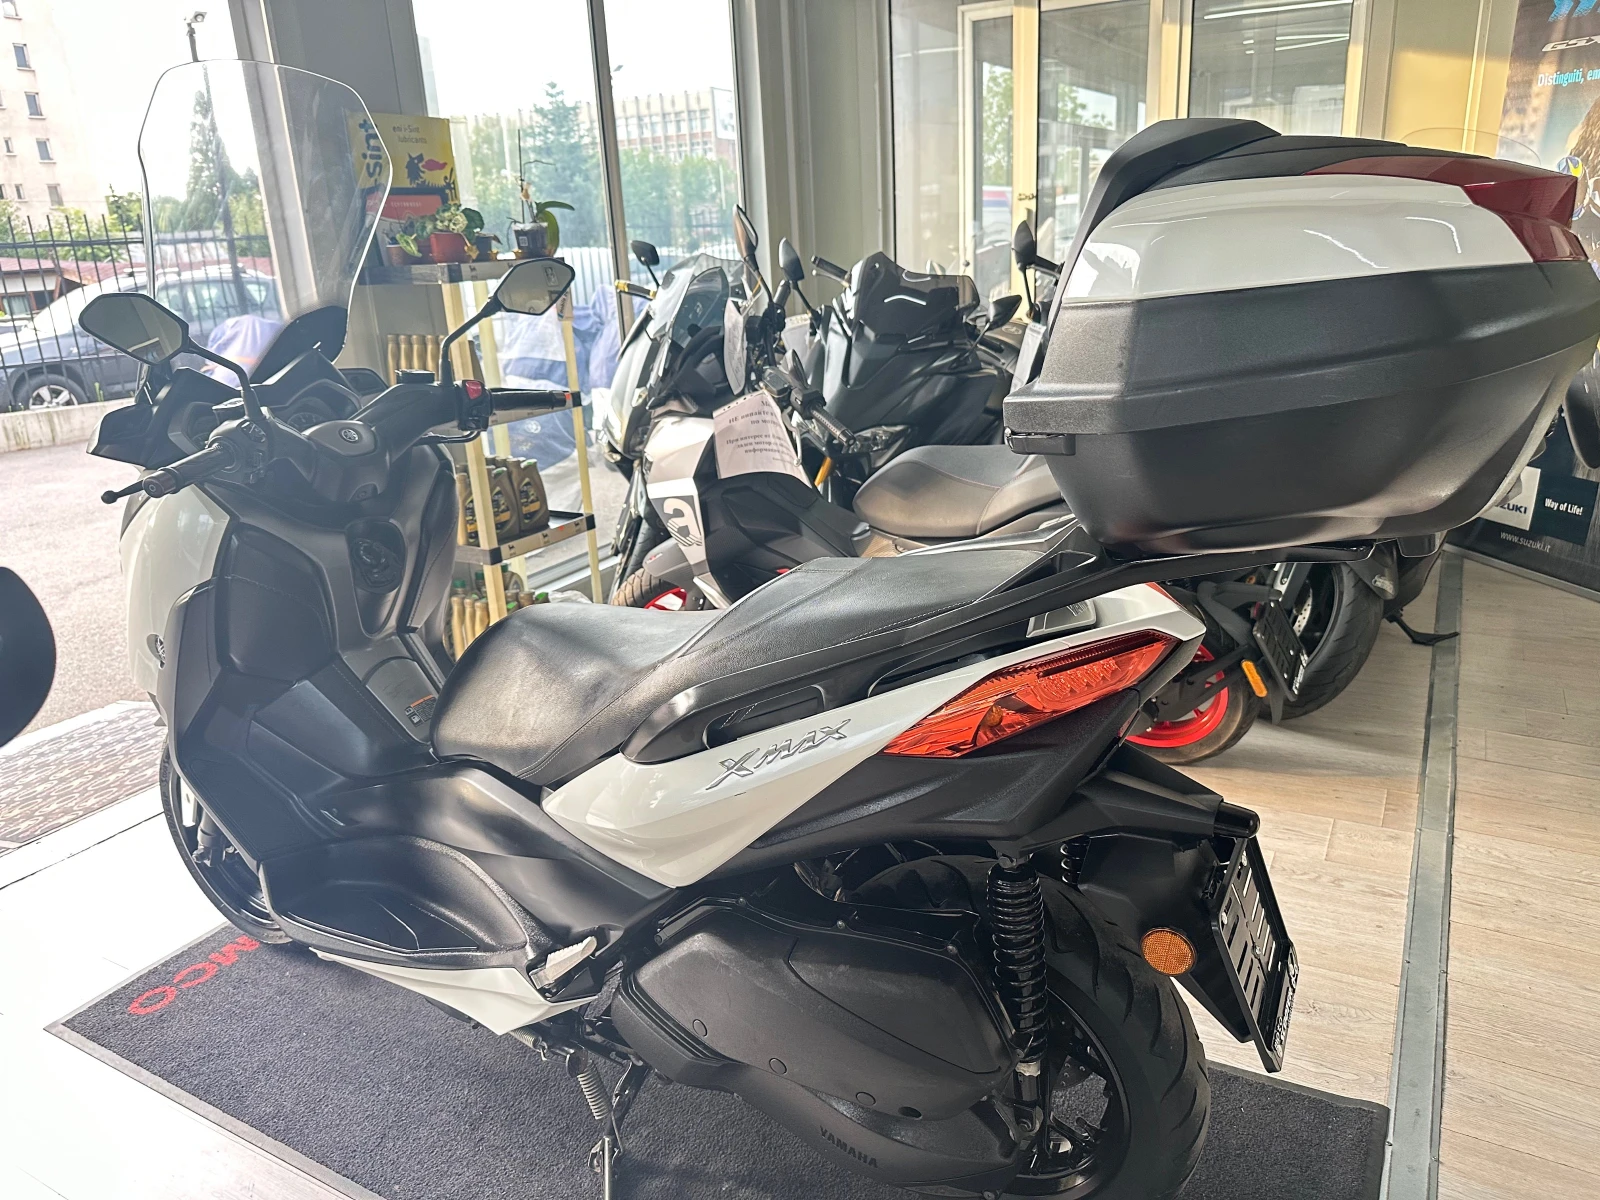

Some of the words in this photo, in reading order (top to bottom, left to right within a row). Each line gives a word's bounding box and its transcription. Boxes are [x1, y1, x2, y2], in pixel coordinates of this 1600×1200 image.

[1537, 68, 1584, 87] Distinguiti,
[1495, 503, 1527, 514] ZUKI
[1544, 498, 1559, 511] Way
[1559, 502, 1568, 511] of
[1567, 504, 1584, 516] Life!
[1500, 532, 1551, 553] www.suzuki.it
[819, 1125, 879, 1168] YAMAHA
